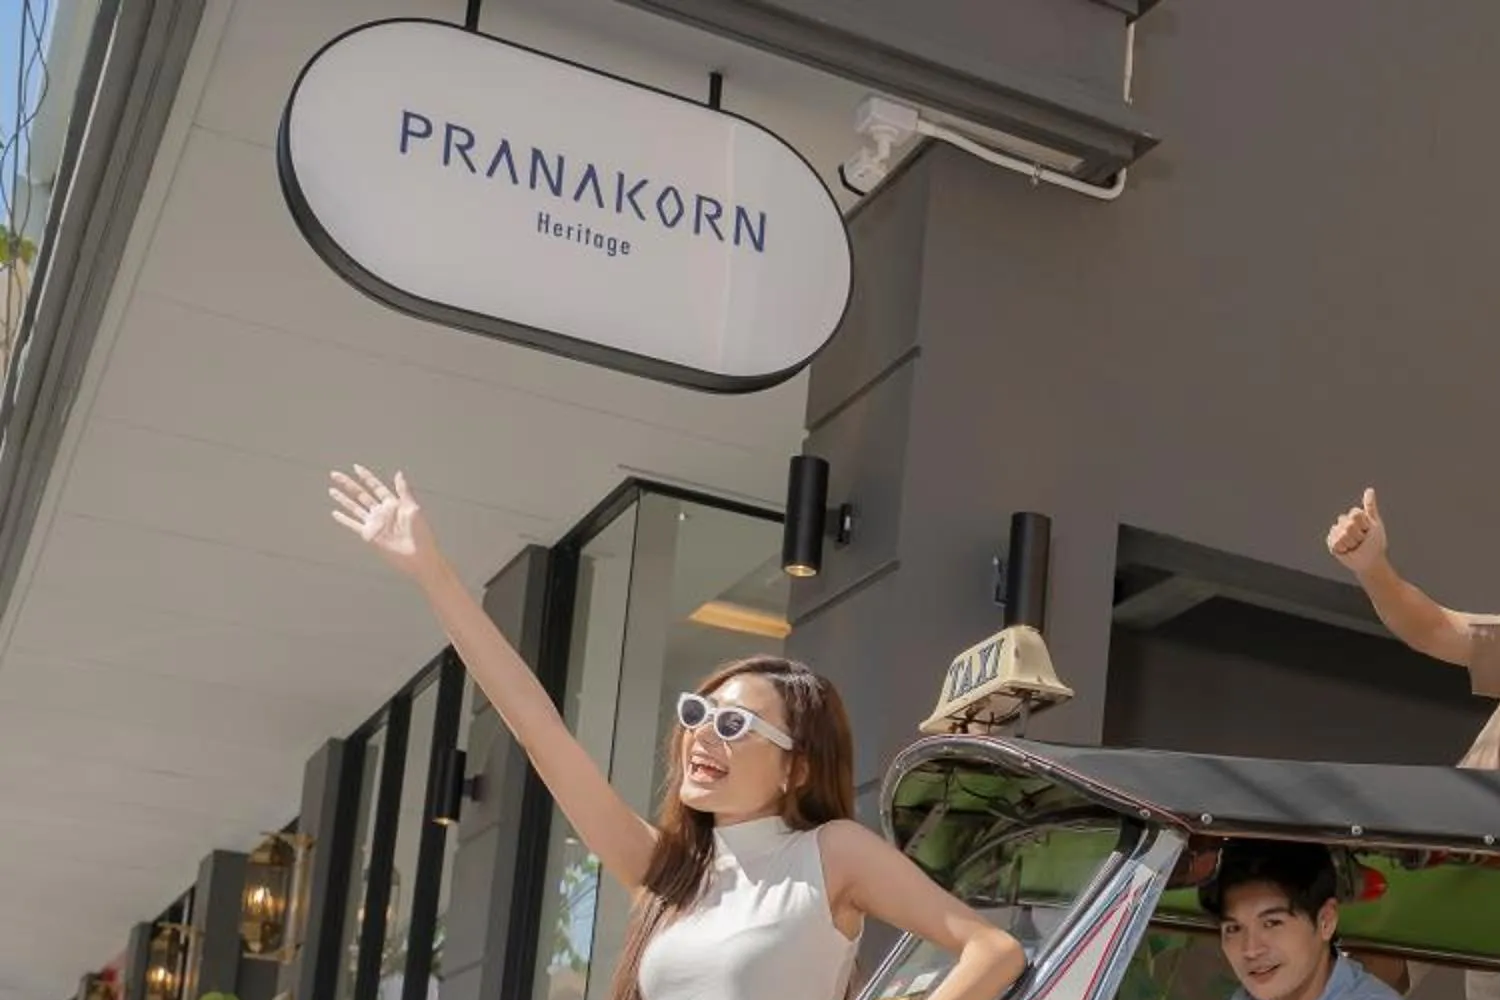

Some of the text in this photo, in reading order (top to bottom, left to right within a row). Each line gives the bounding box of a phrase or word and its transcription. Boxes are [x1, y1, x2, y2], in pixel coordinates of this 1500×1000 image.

[399, 109, 767, 253] PRANAKORN
[536, 211, 632, 257] Heritage
[947, 637, 1005, 702] TAXI
